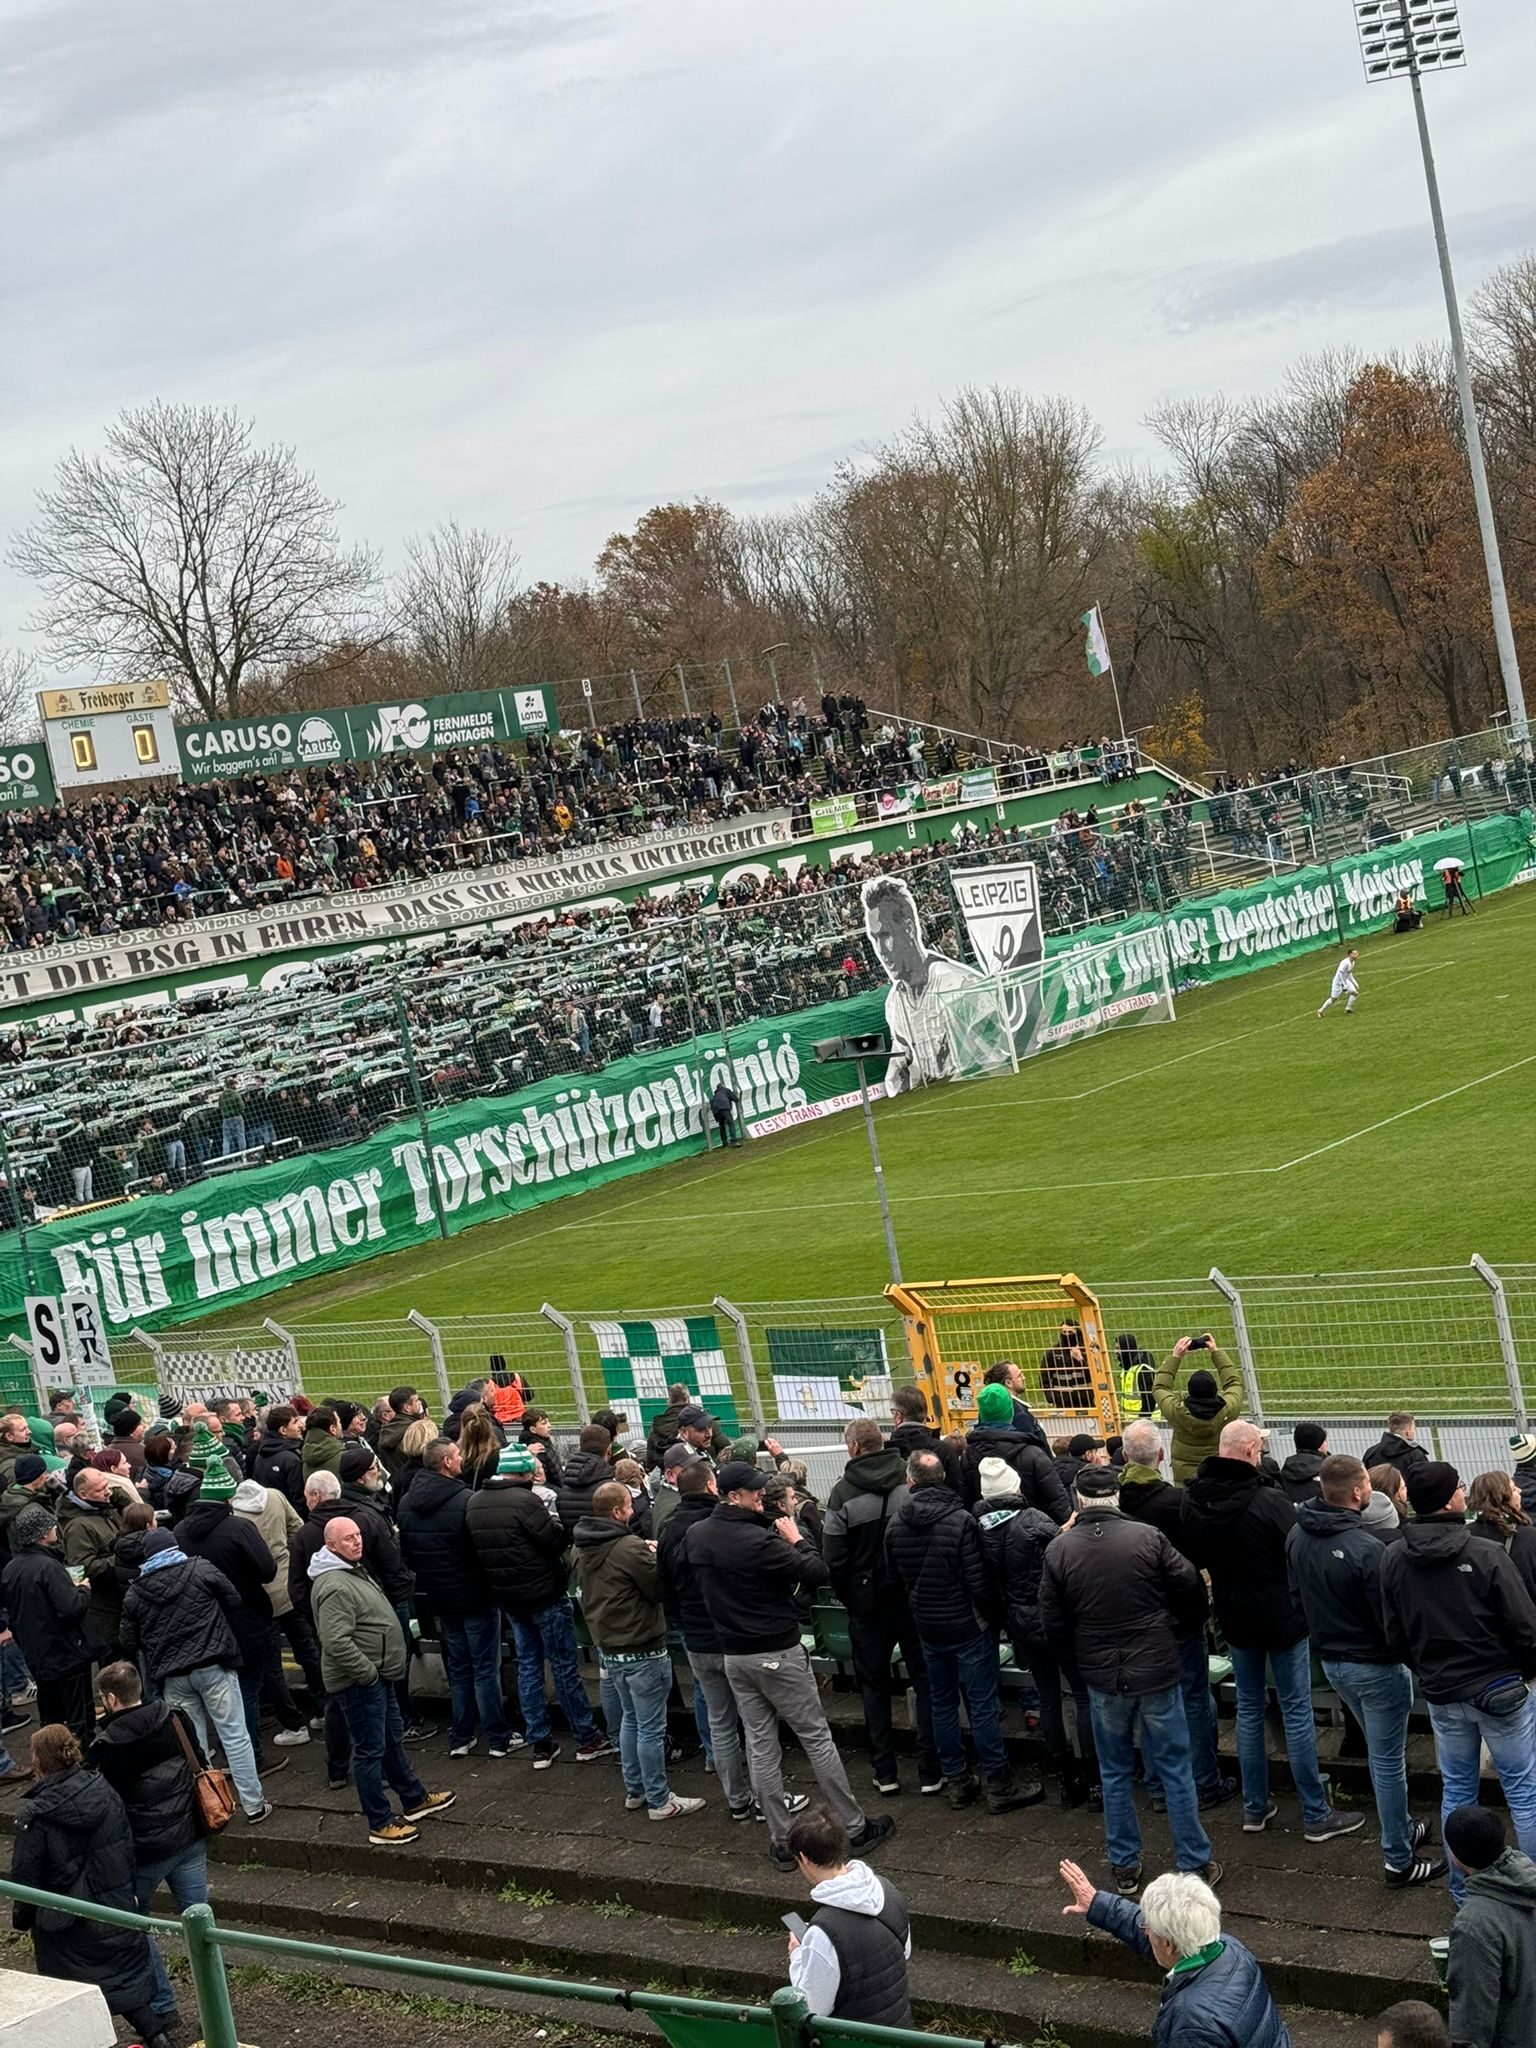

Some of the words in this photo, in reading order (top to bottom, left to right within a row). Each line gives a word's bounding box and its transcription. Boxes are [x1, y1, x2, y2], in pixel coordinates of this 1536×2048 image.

[78, 691, 135, 709] Freiberger
[61, 718, 96, 730] CHEMIE
[433, 711, 494, 731] FERNMELDE
[521, 710, 544, 721] LOTTO
[72, 735, 92, 767] 0
[134, 729, 154, 761] 0
[185, 722, 292, 758] CARUSO
[297, 740, 342, 756] CARUSO
[433, 726, 495, 746] MONTAGEN
[191, 761, 211, 776] Wir
[212, 755, 260, 774] baggern's
[262, 752, 278, 767] an!
[815, 803, 851, 817] CHEMIE
[330, 885, 406, 908] CHEMIE
[410, 870, 477, 894] LEIPZIG
[492, 856, 549, 877] UNSER
[607, 838, 641, 853] NUR
[678, 822, 714, 839] DICH
[45, 955, 118, 991] DIE
[125, 939, 201, 975] BSG
[210, 931, 248, 958] IN
[385, 888, 465, 923] DASS
[466, 880, 516, 905] SIE
[516, 857, 629, 894] NIEMALS
[630, 826, 767, 872] UNTERGEHT
[399, 914, 440, 931] 1964
[450, 890, 566, 924] POKALSIEGER
[570, 880, 606, 898] 1966
[960, 879, 1027, 909] LEIPZIG
[1212, 884, 1338, 962] Deutscher
[1341, 858, 1428, 924] Meister
[832, 1086, 883, 1107] Strach.
[50, 1226, 173, 1324] Für
[181, 1167, 387, 1299] immer
[391, 1032, 807, 1225] Torschützenkönig
[34, 1303, 60, 1365] S
